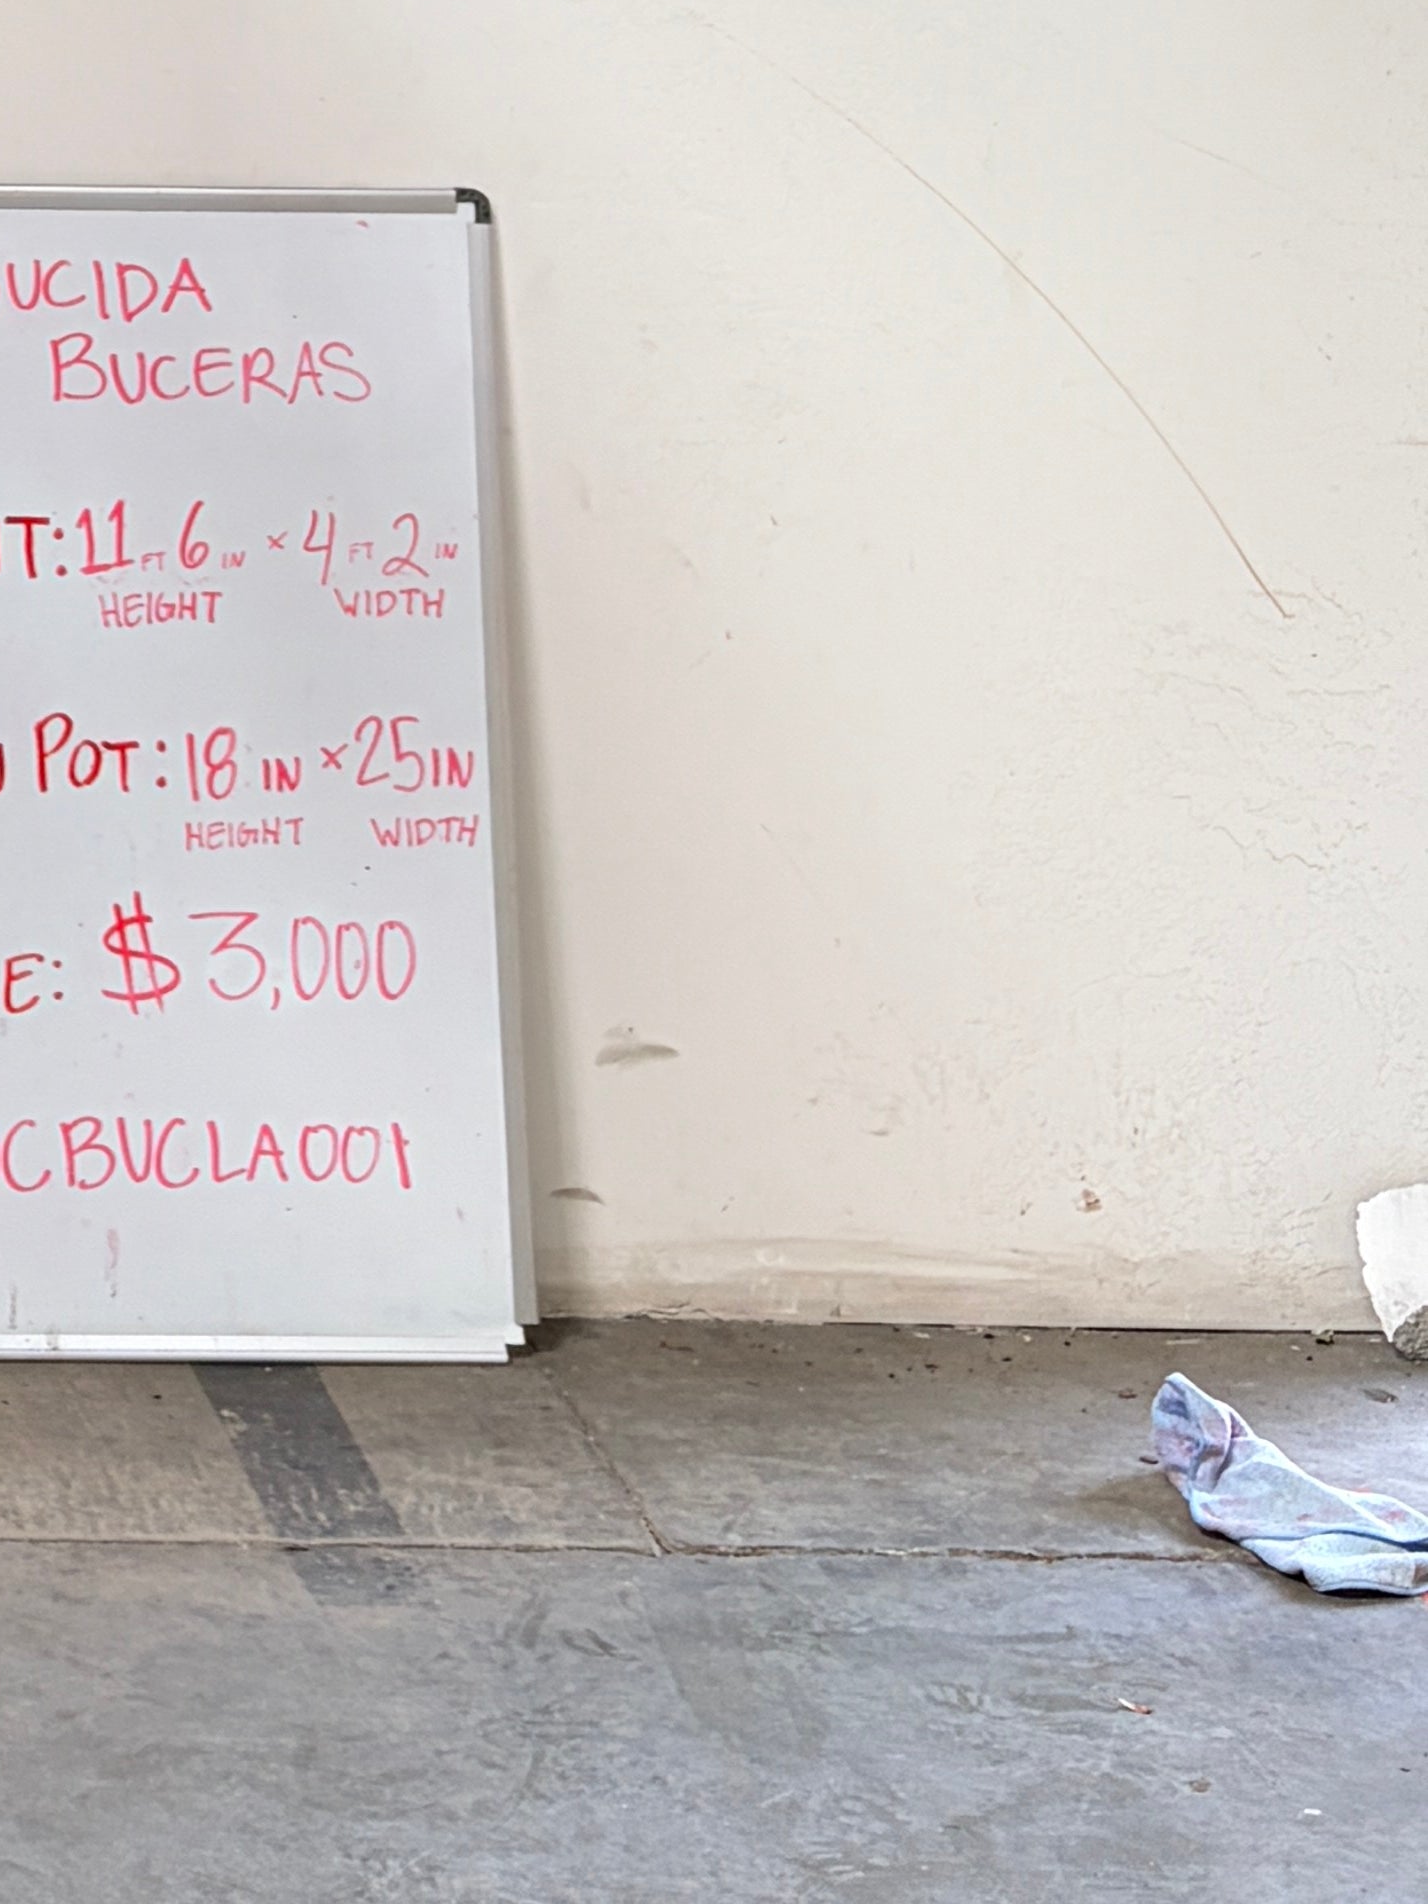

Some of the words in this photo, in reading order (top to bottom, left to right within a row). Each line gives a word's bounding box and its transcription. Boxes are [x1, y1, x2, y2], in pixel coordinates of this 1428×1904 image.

[47, 331, 372, 407] BUCERAS
[176, 499, 211, 572] 6
[301, 510, 337, 587] 4
[380, 512, 428, 578] 2
[98, 590, 223, 630] HEIGHT
[333, 587, 446, 620] WIDTH
[31, 711, 169, 796] POT:
[183, 725, 239, 804] 18
[183, 816, 303, 852] HEIGHT
[369, 815, 480, 849] WIDTH
